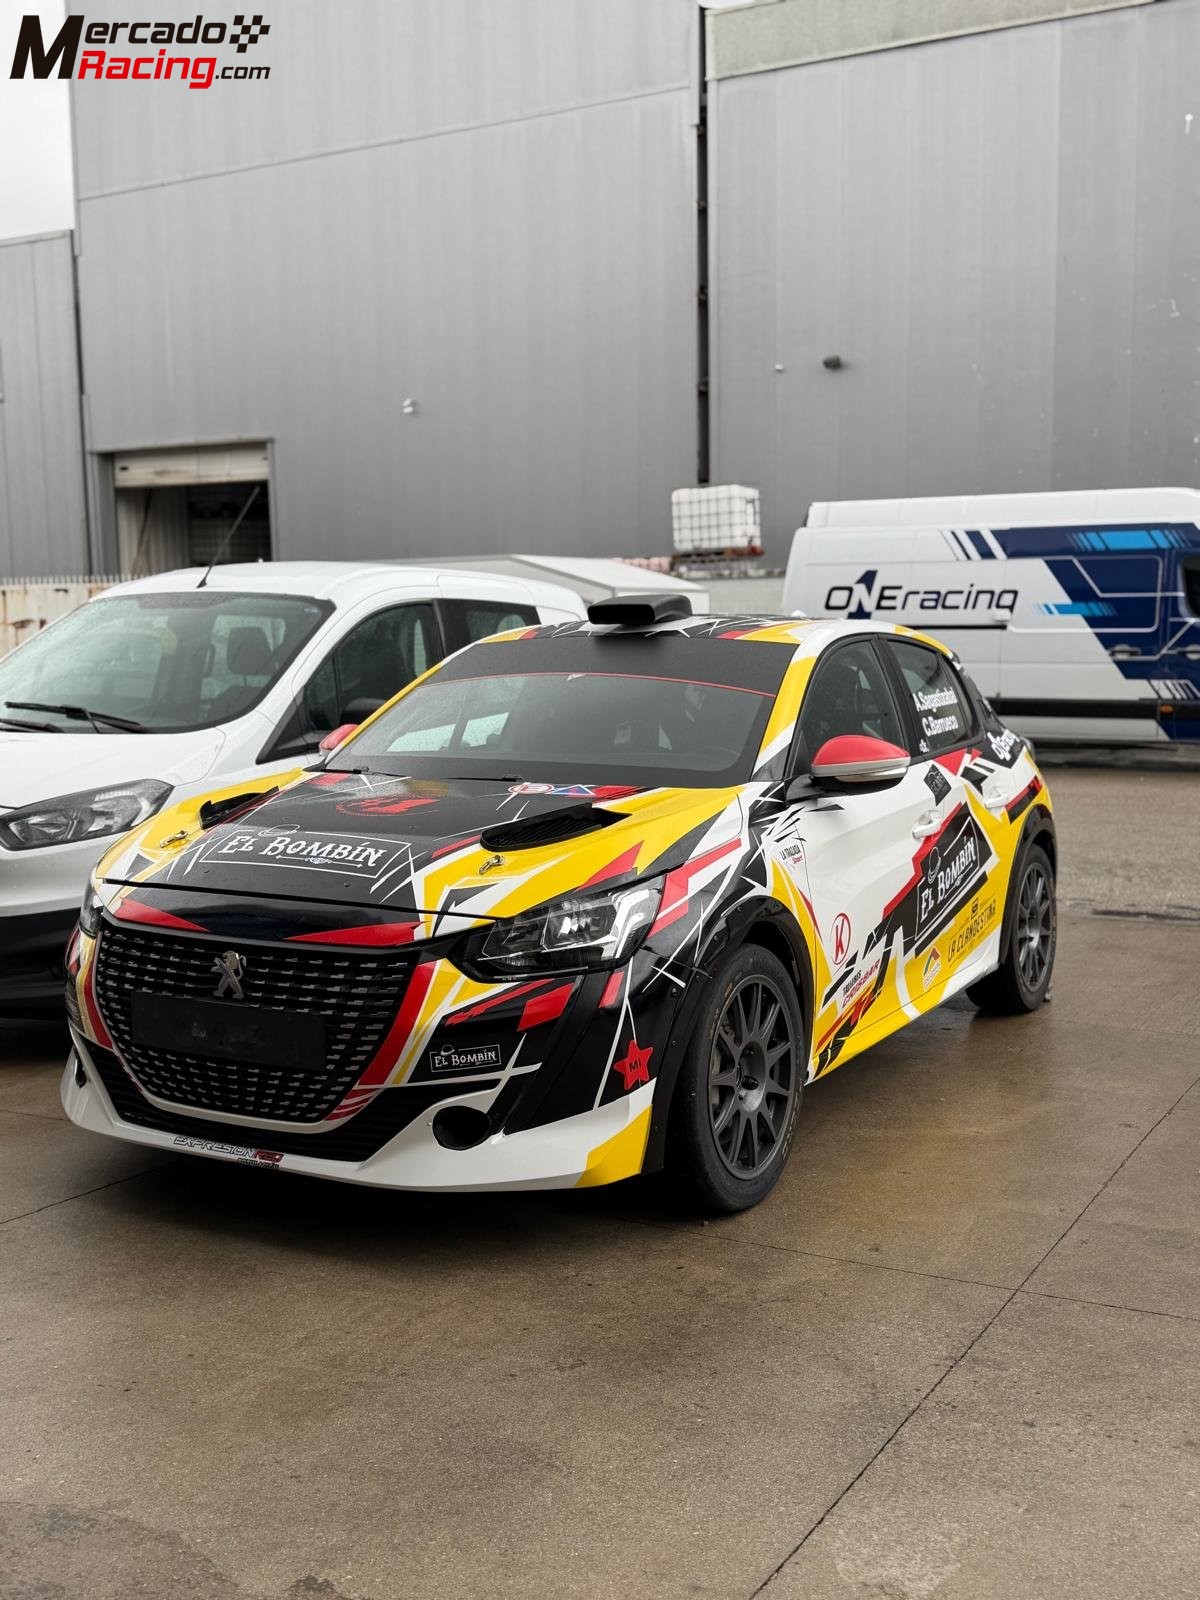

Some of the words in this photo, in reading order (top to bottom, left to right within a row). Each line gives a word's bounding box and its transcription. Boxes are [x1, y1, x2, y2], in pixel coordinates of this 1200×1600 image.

[259, 837, 388, 867] BOMBÍN
[920, 888, 934, 923] EL
[937, 836, 977, 904] BOMBÍN
[434, 1056, 449, 1067] EL
[451, 1049, 497, 1066] BOMBÍN
